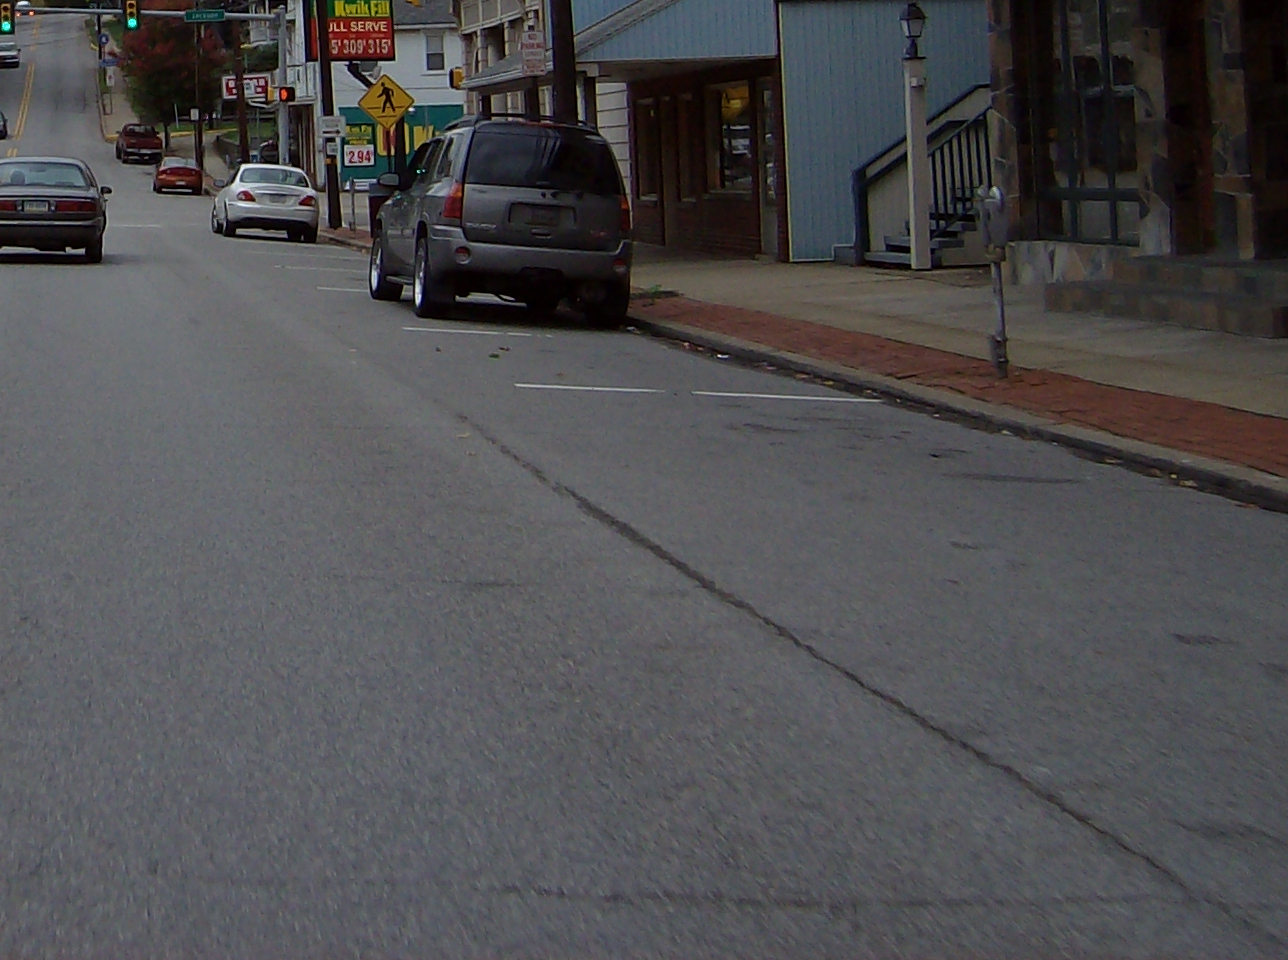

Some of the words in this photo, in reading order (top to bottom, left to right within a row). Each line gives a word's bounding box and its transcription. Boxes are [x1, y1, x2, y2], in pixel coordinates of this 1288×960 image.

[334, 0, 370, 17] Kwik
[370, 0, 390, 17] Fill
[328, 22, 348, 32] ULL
[350, 21, 388, 32] SERVE
